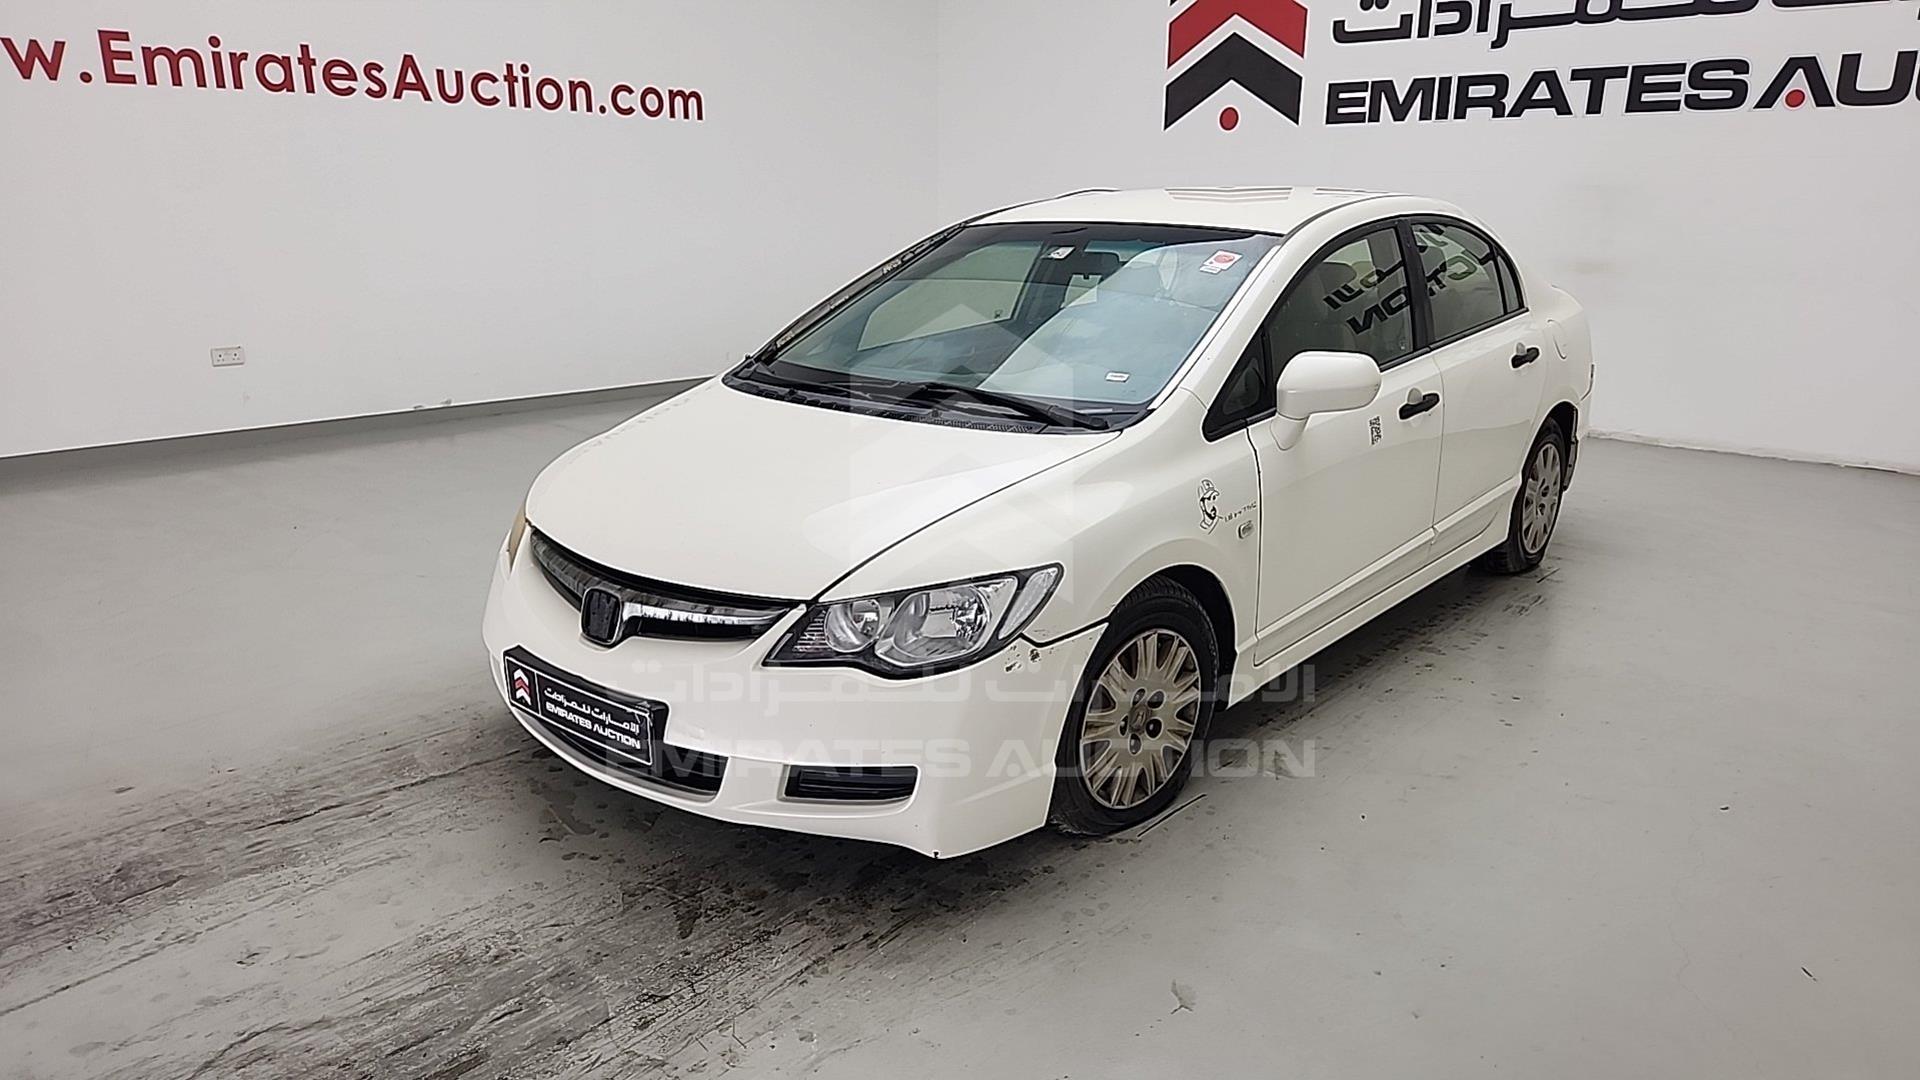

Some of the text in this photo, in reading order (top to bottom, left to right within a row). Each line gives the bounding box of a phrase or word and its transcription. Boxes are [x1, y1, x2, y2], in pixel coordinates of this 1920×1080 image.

[1753, 51, 1920, 109] AU
[546, 701, 640, 750] EMIRATES AUCTION
